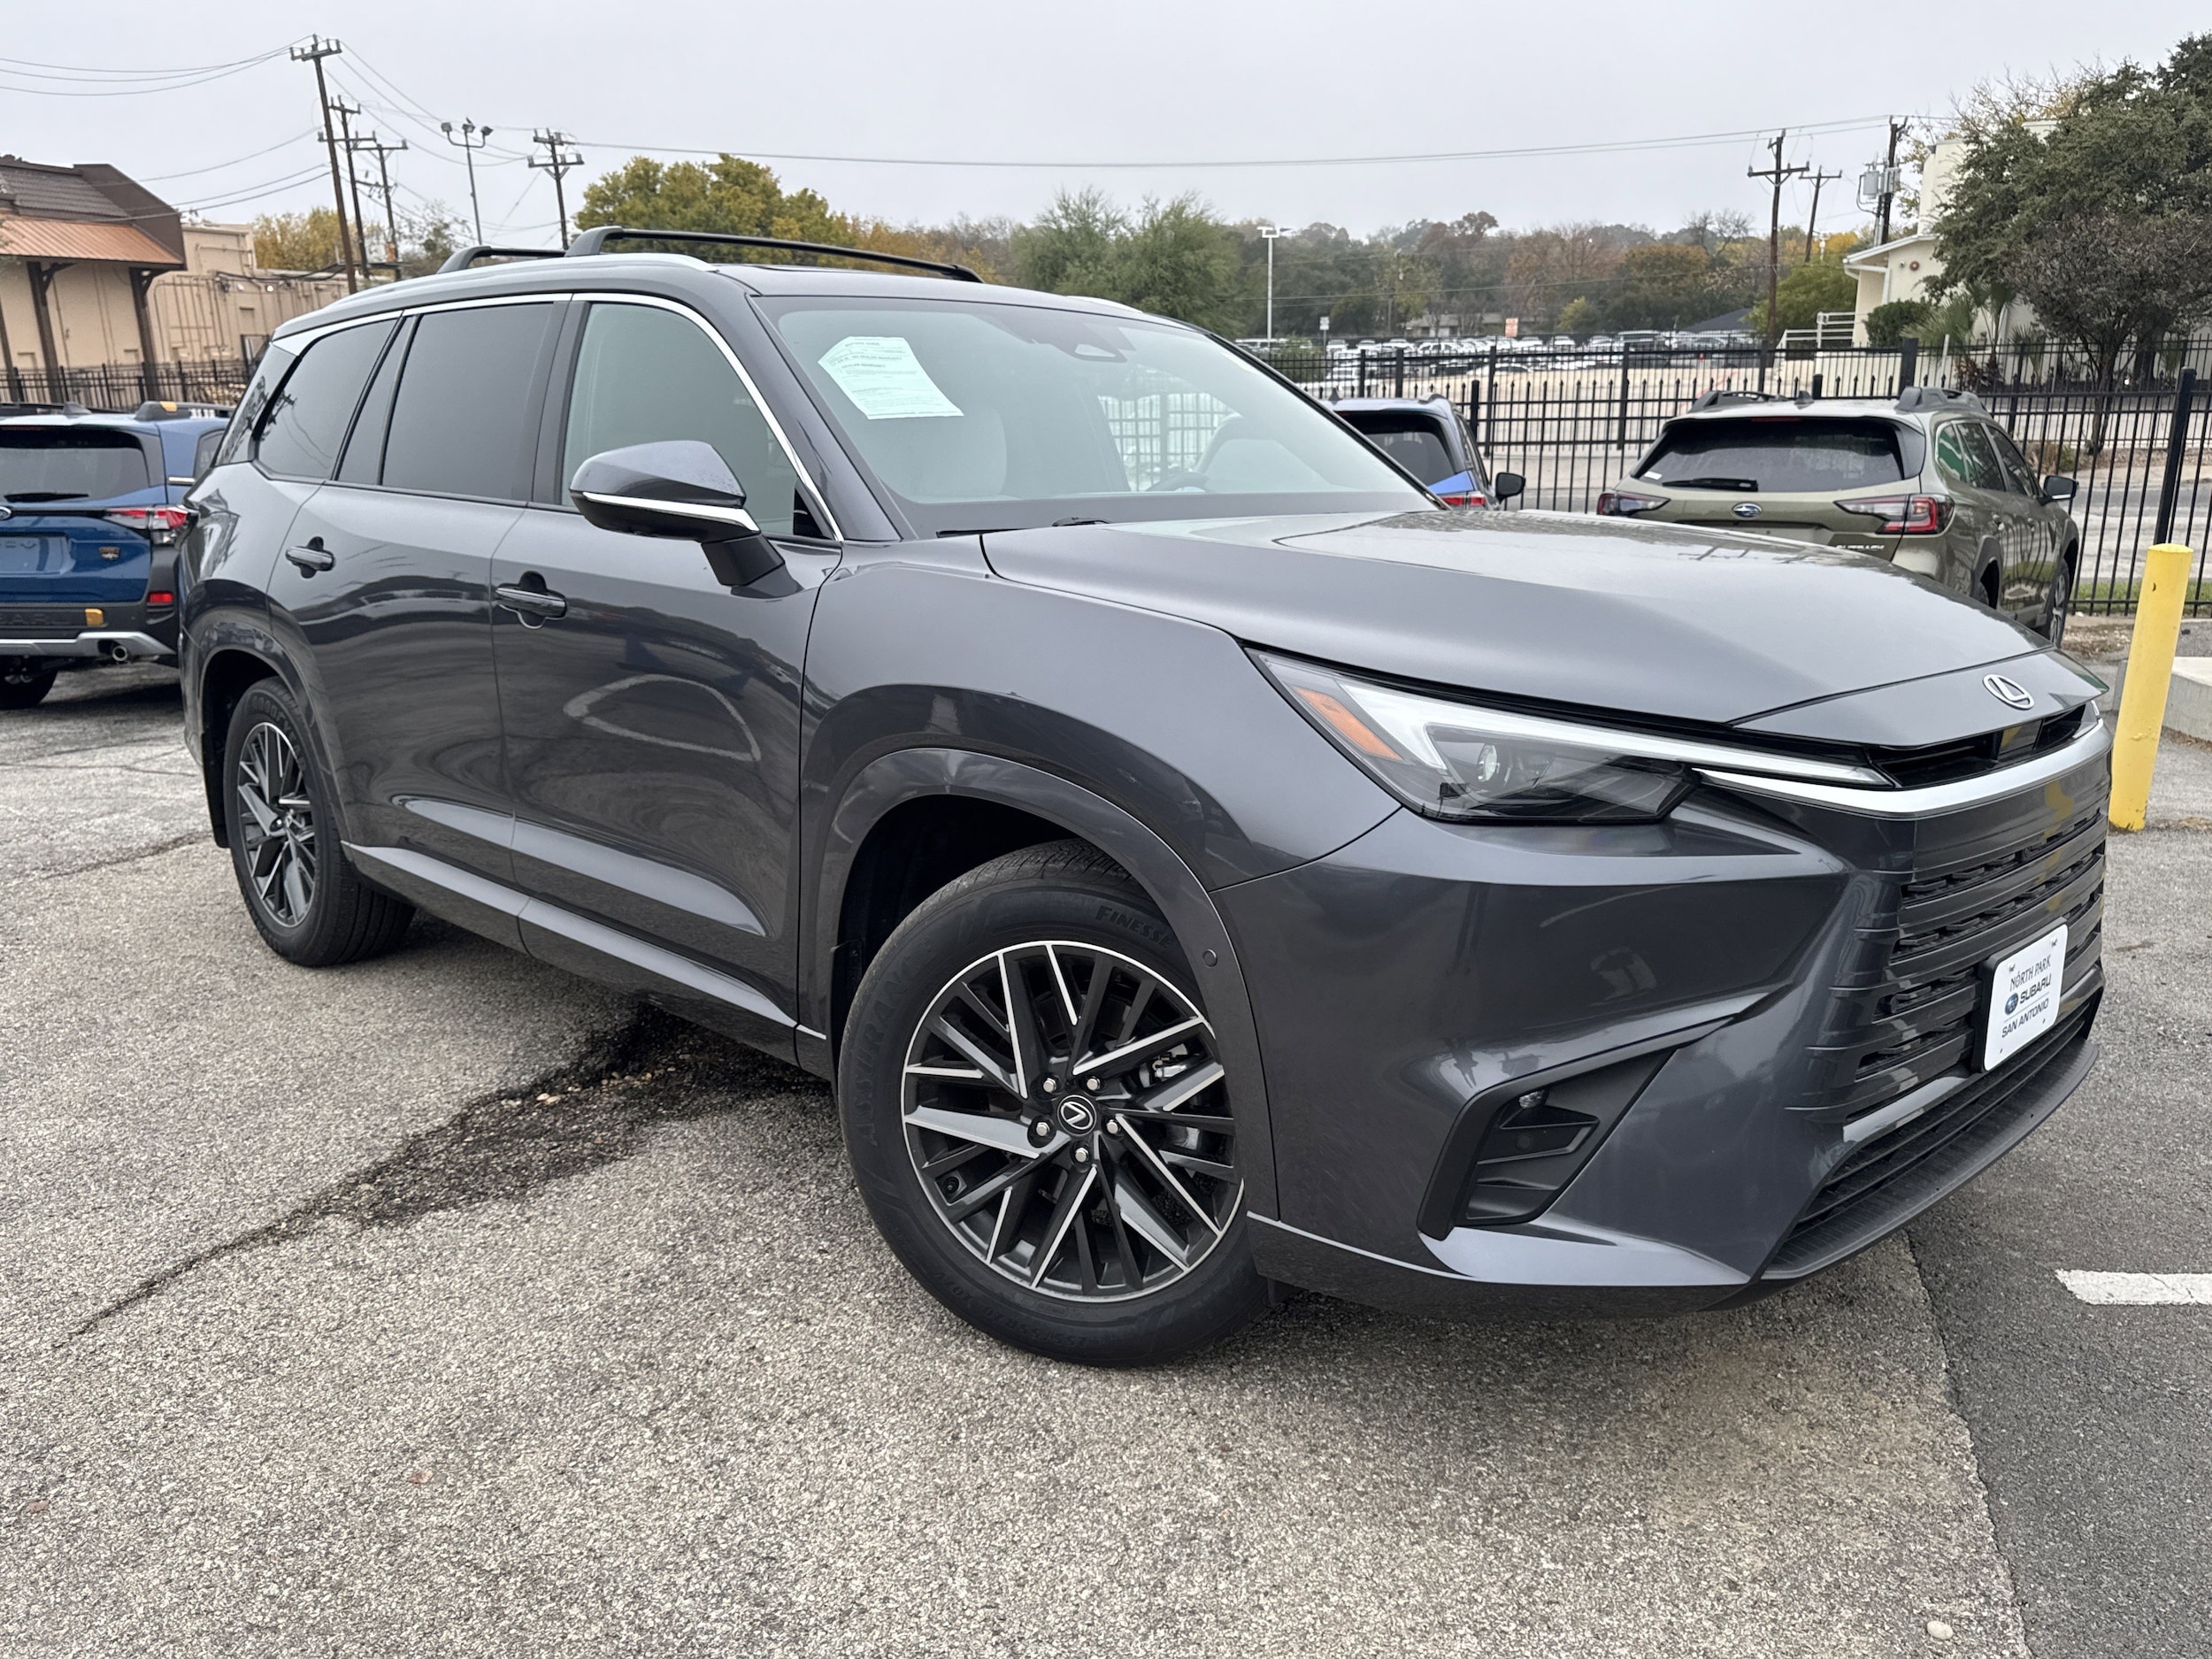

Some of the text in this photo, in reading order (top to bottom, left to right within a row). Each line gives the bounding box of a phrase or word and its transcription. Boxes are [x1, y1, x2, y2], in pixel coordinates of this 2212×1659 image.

[1094, 906, 1172, 949] FINESSE
[2009, 955, 2051, 992] NORTH PARK
[2019, 974, 2052, 1004] SUBARU
[2001, 997, 2049, 1038] SAN ANTONIO
